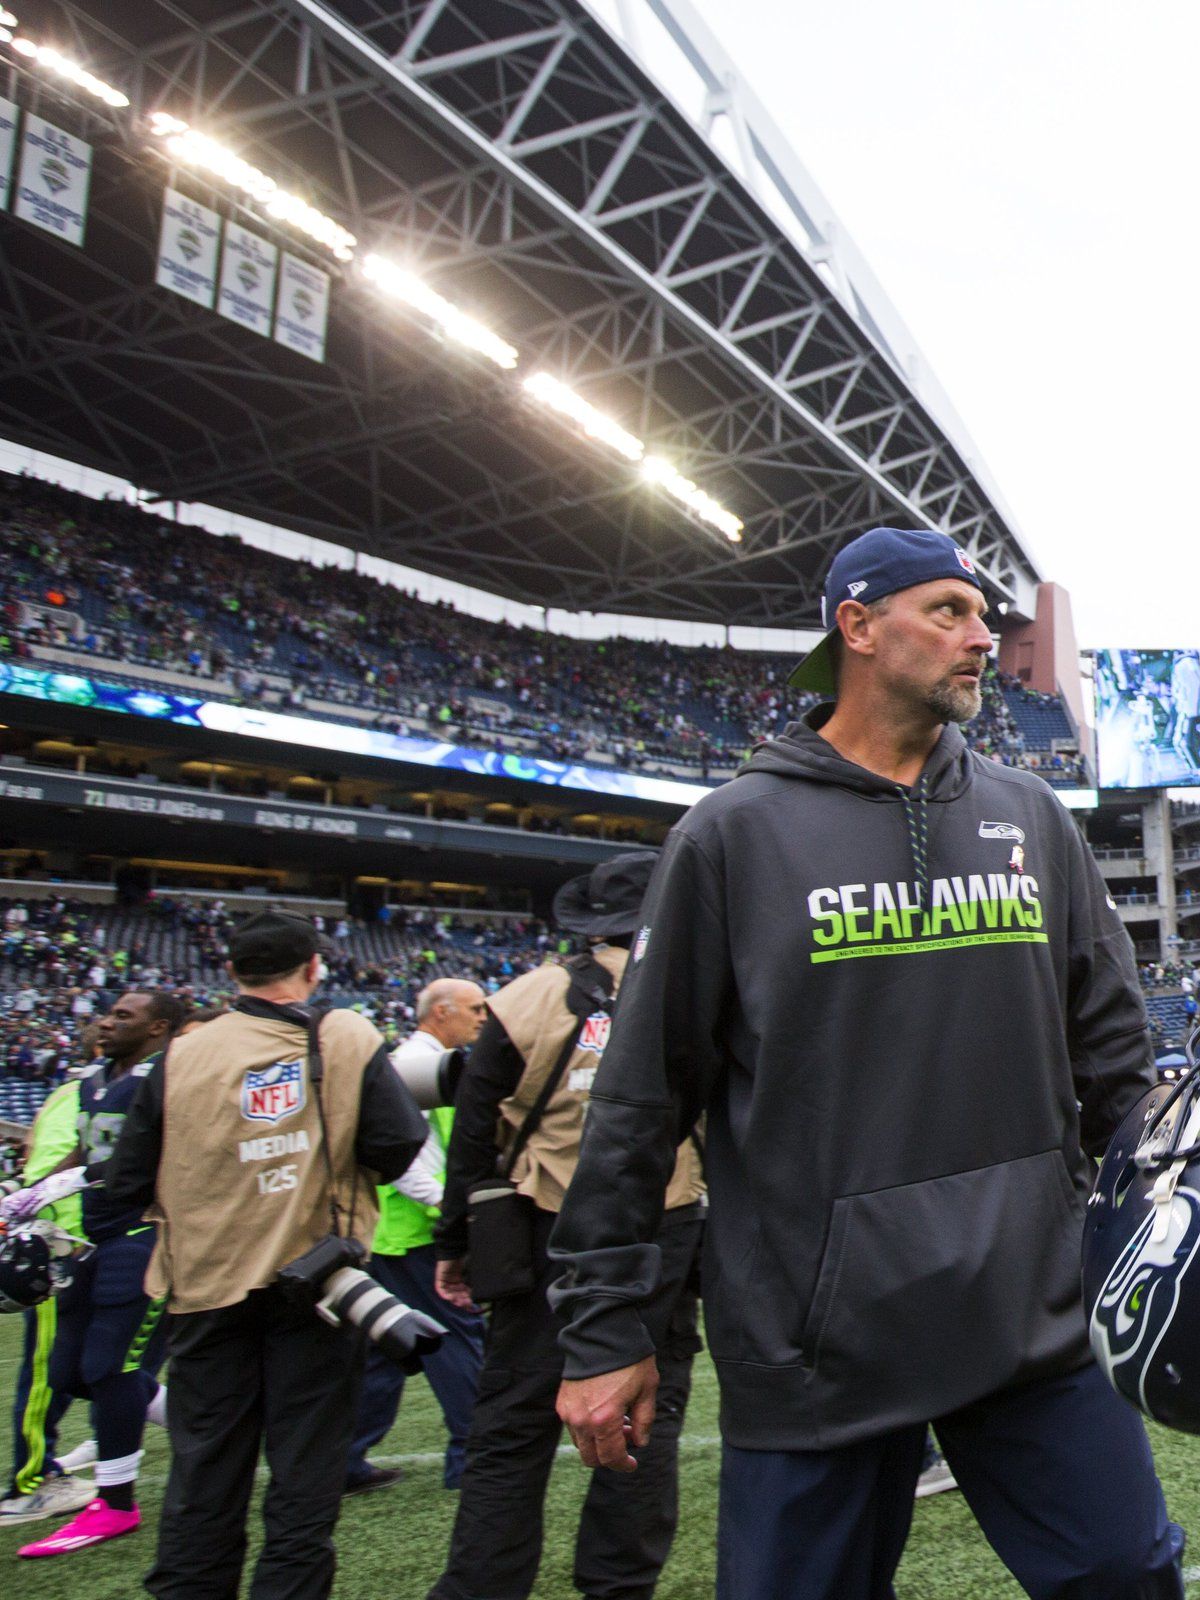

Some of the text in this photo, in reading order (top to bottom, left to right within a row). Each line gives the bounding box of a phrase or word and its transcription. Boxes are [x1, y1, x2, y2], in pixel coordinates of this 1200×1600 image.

[807, 873, 1043, 946] SEAHAWKS
[250, 1084, 298, 1114] NFL
[238, 1130, 310, 1162] MEDIA
[257, 1164, 298, 1194] 125
